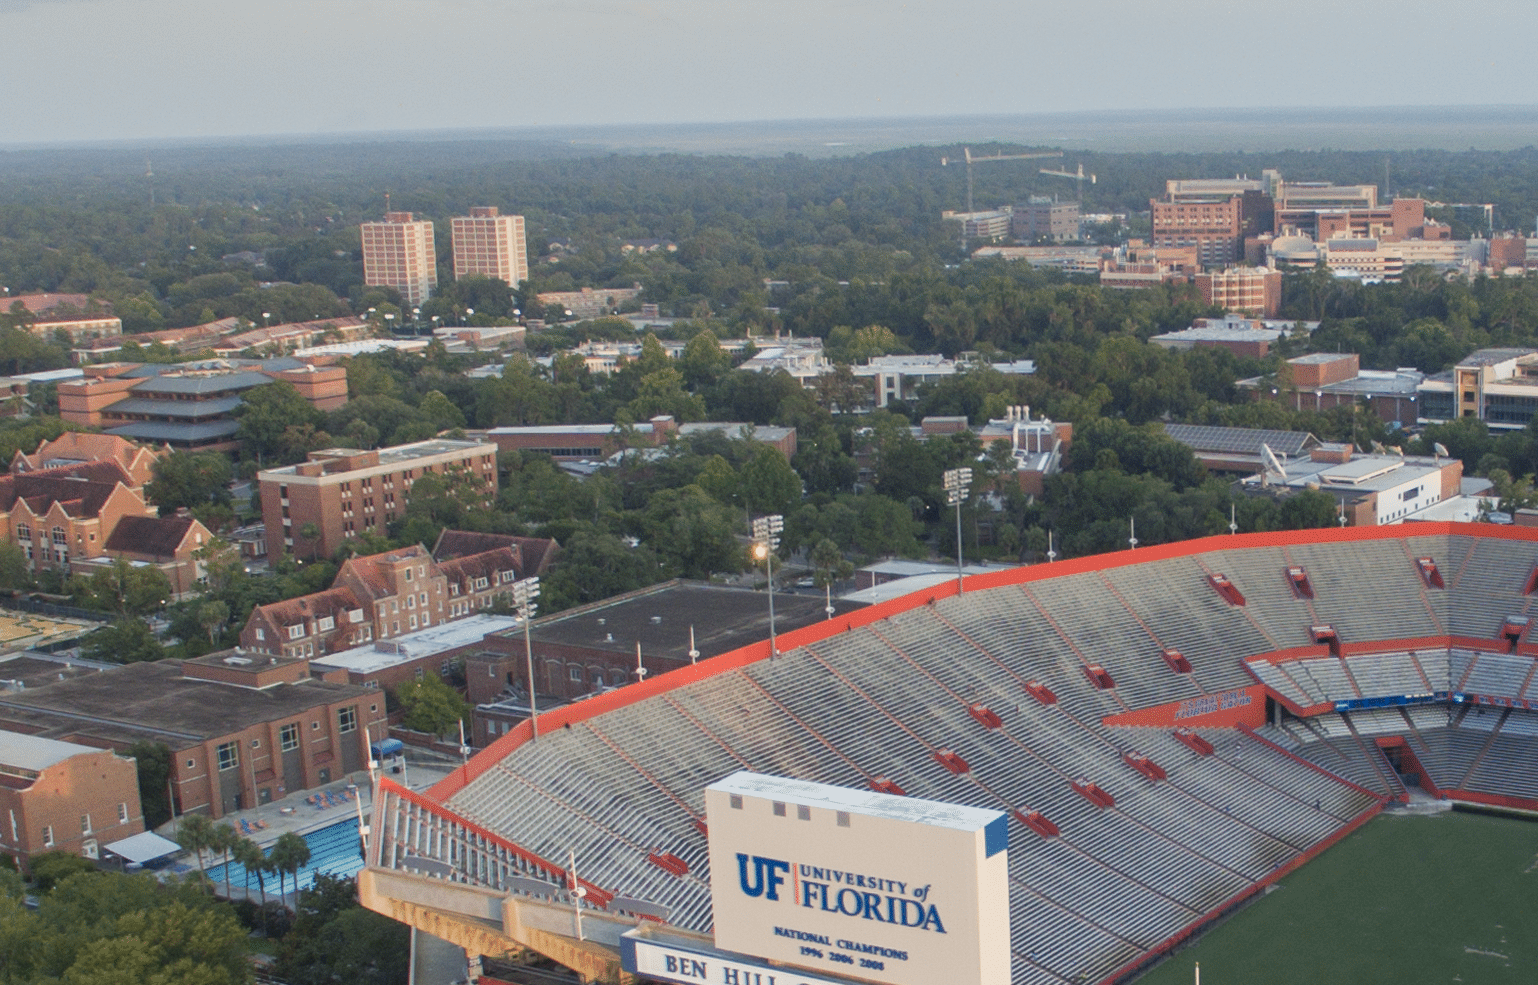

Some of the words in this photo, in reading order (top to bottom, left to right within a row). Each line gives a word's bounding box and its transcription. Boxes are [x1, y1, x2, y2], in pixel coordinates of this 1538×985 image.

[736, 853, 790, 902] UF
[800, 863, 907, 896] UNIVERSITY
[914, 884, 932, 901] of
[801, 880, 948, 934] FLORIDA
[774, 926, 831, 947] NATIONAL
[836, 939, 909, 961] CHAMPIONS
[800, 946, 823, 960] 1996
[829, 952, 854, 965] 2006
[859, 958, 885, 971] 2008
[665, 954, 708, 980] BEN
